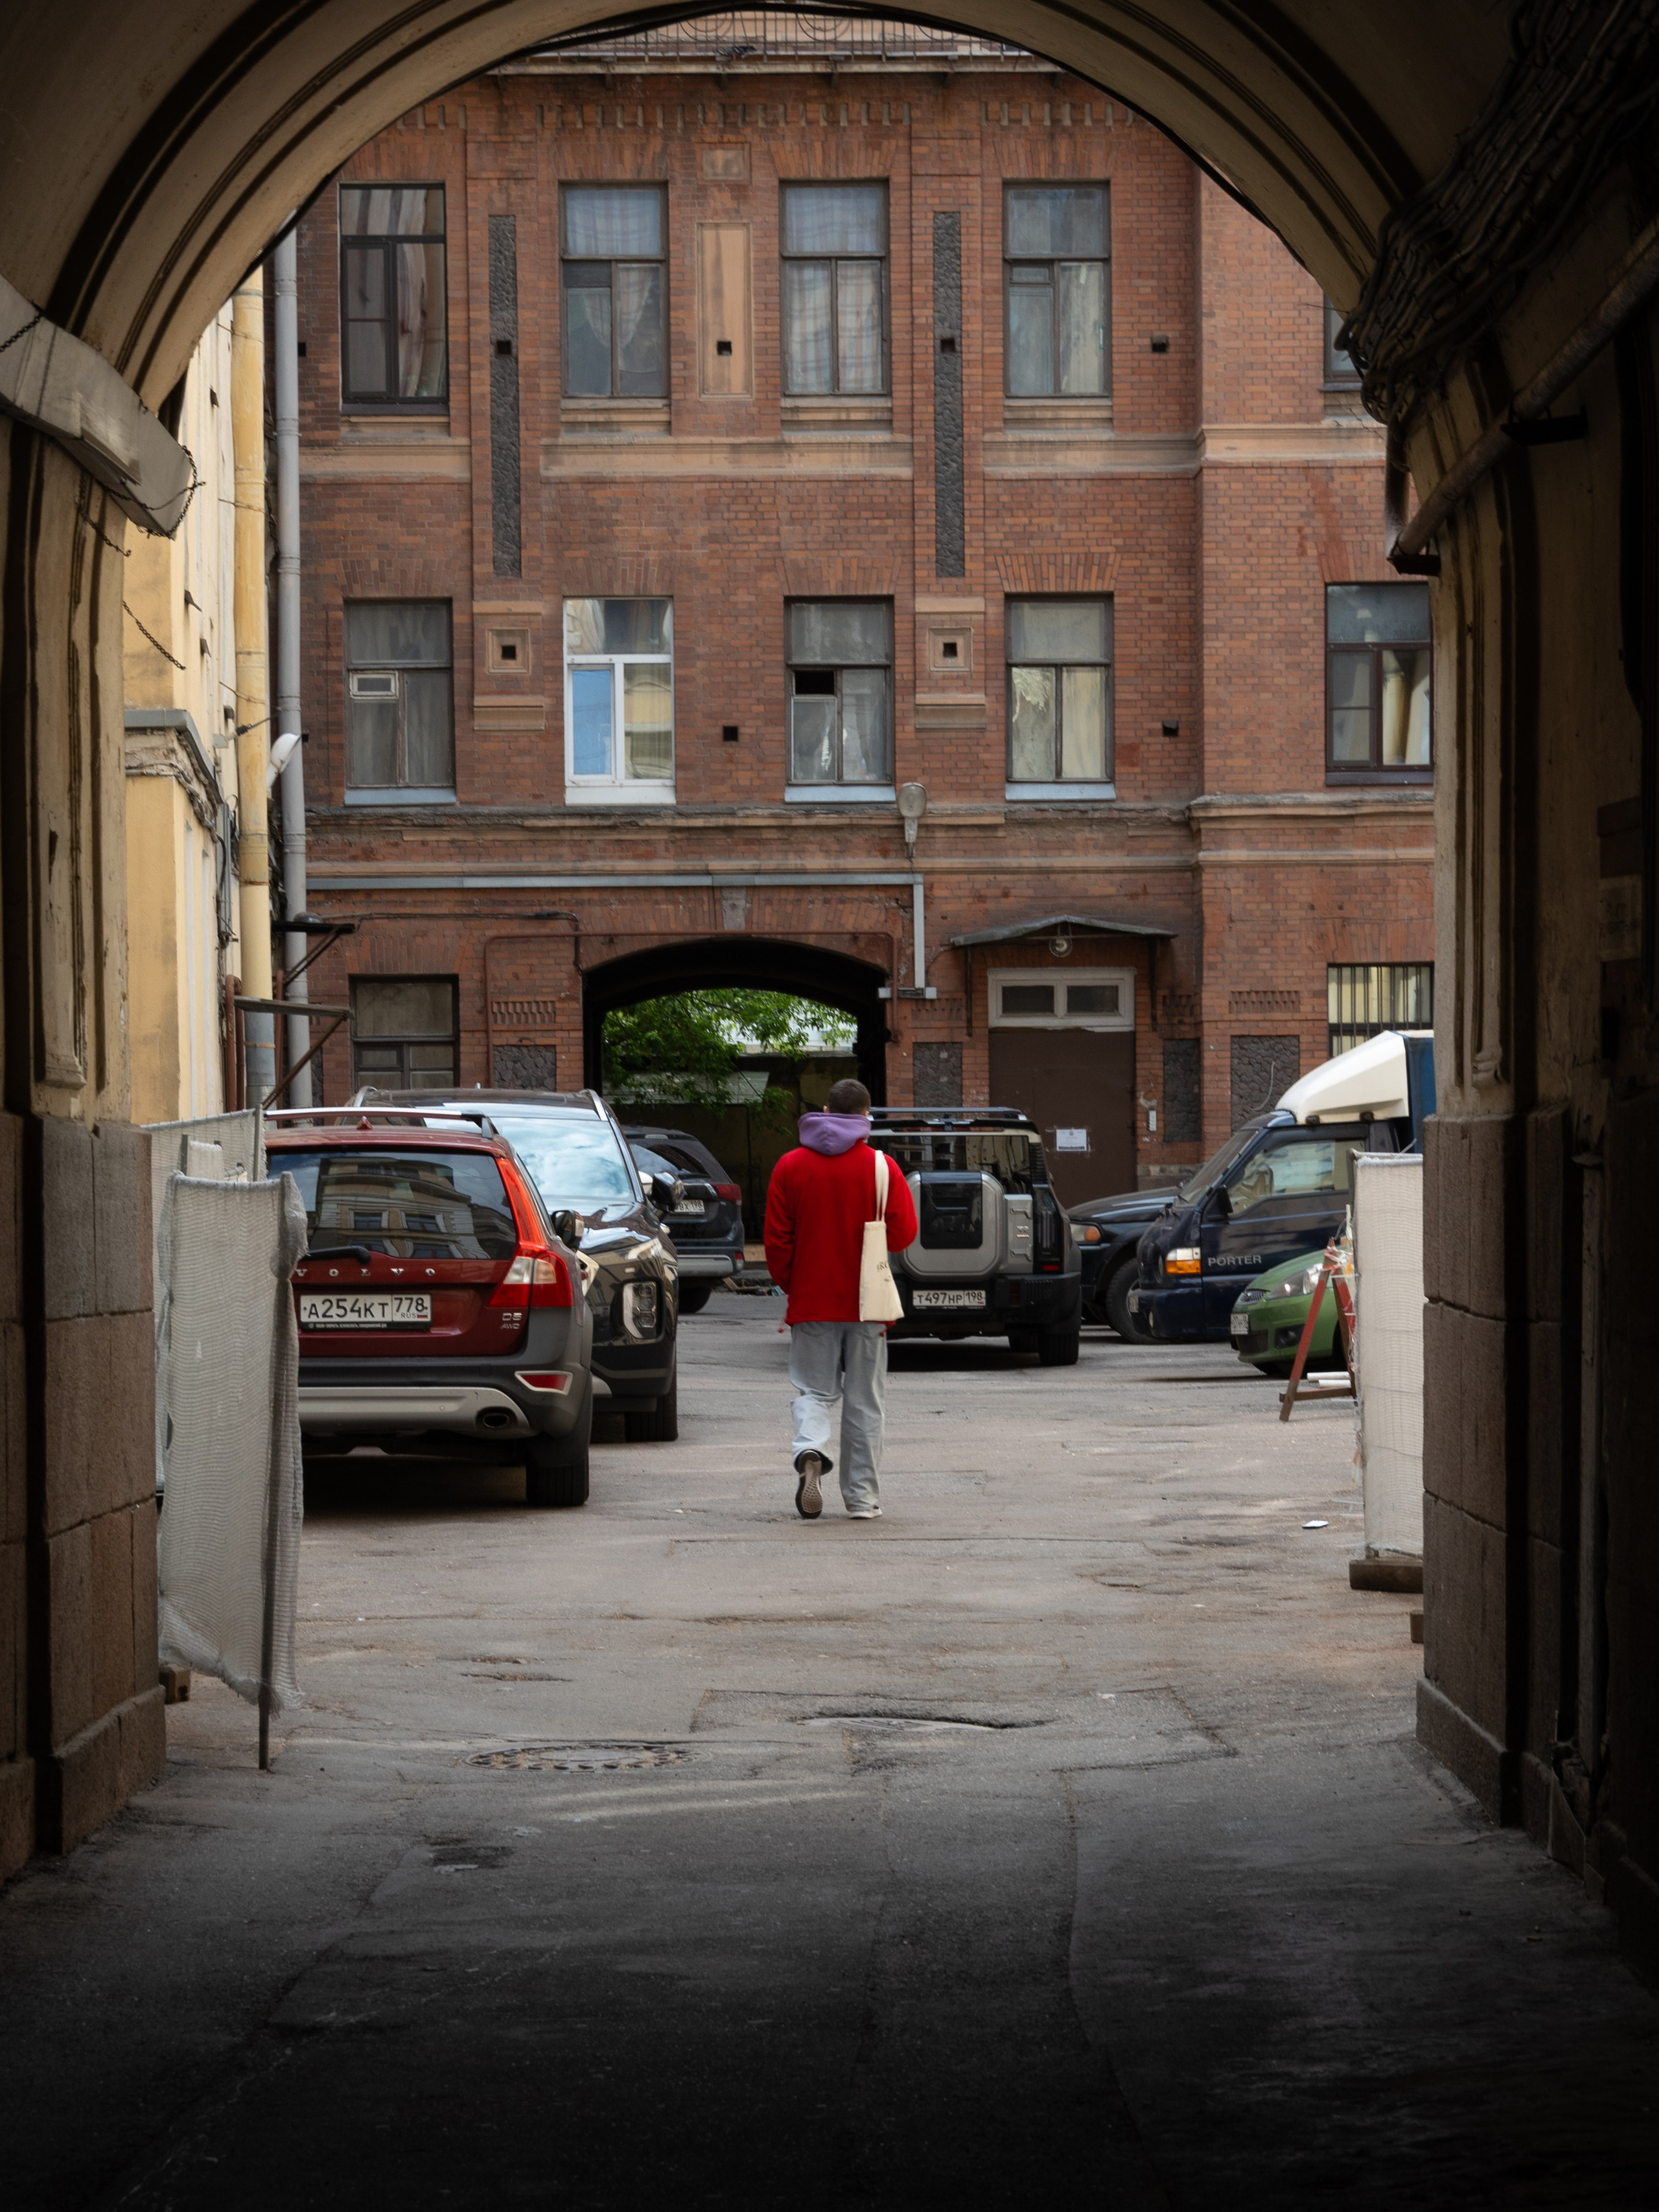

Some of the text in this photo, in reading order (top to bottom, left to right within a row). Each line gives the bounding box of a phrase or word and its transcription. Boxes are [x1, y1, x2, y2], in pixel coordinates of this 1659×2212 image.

[1207, 1255, 1262, 1267] PORTER
[294, 1268, 435, 1277] VOLVO
[916, 1291, 983, 1304] Т497НР 198
[307, 1297, 425, 1319] А254КТ 778
[502, 1312, 522, 1321] D5
